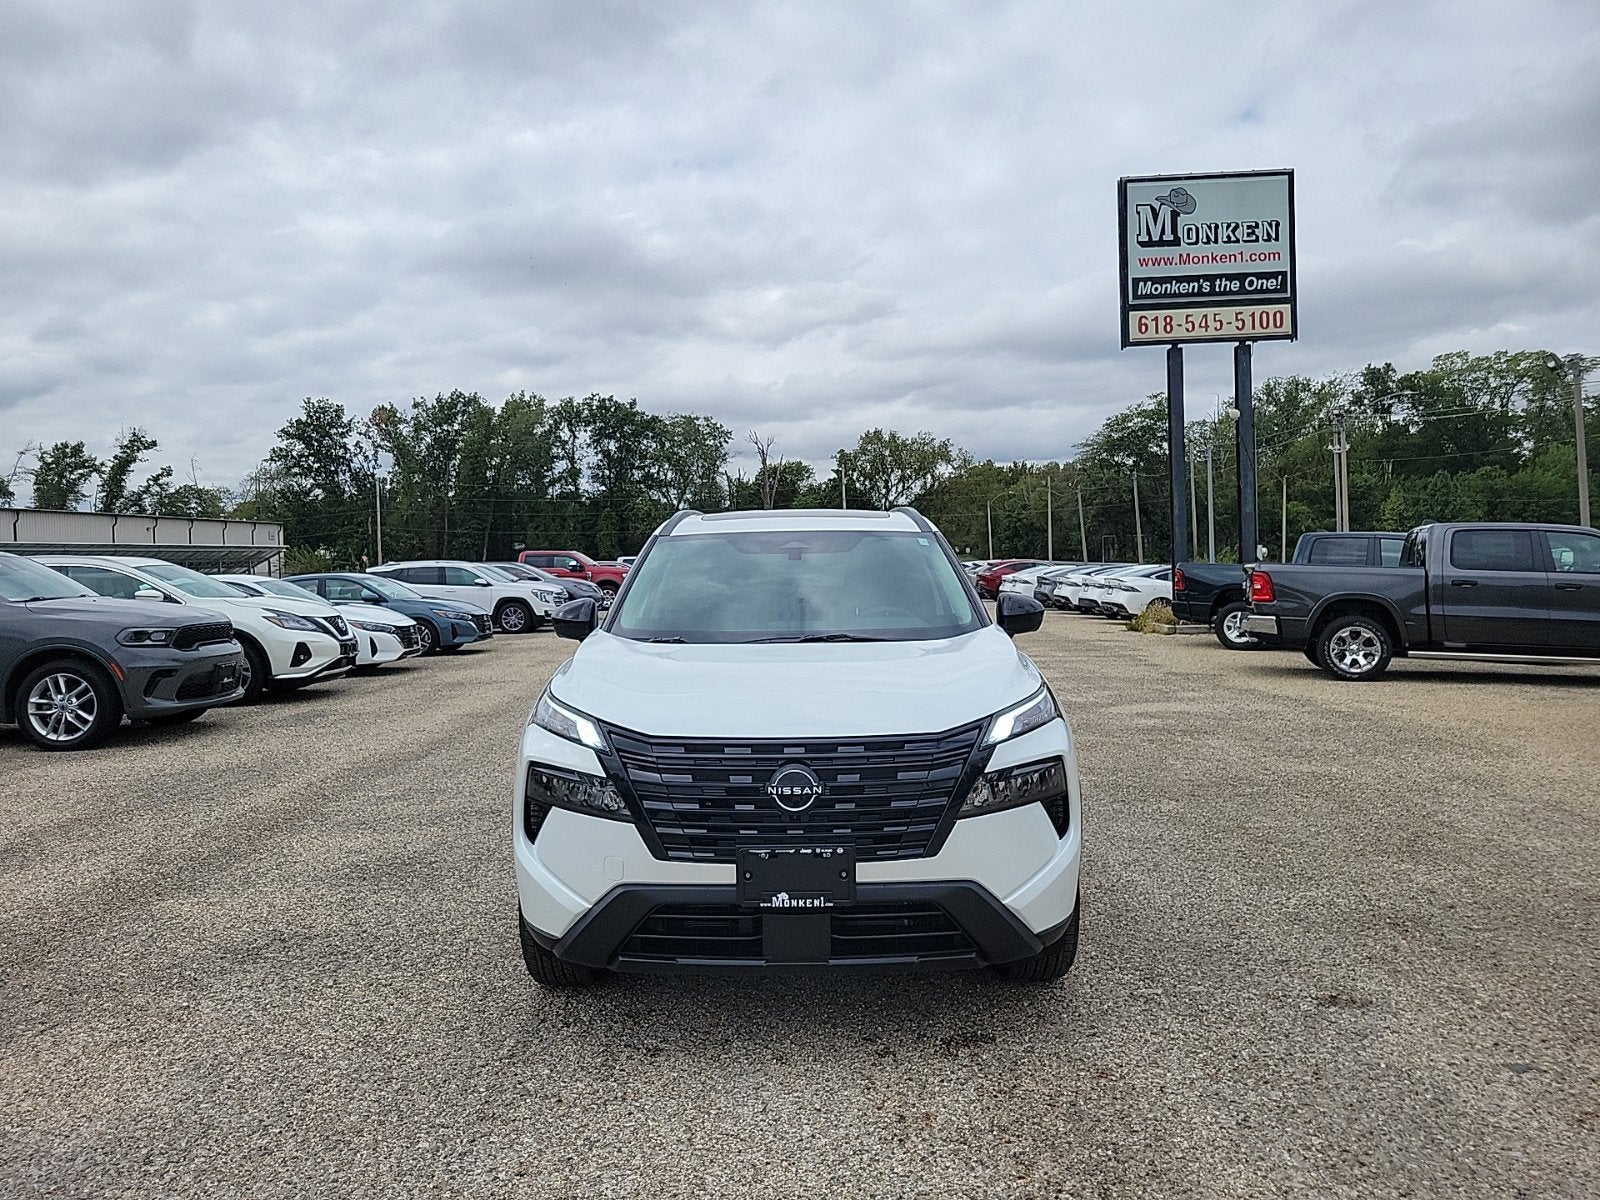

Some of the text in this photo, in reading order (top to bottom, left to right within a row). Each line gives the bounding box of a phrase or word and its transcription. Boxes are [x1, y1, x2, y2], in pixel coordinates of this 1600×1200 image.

[1136, 203, 1281, 248] MONKEN
[1138, 251, 1281, 268] www.Monken1.com
[1138, 275, 1282, 296] Monken's the One!
[1137, 309, 1284, 335] 618-545-5100
[767, 786, 822, 795] NISSAN
